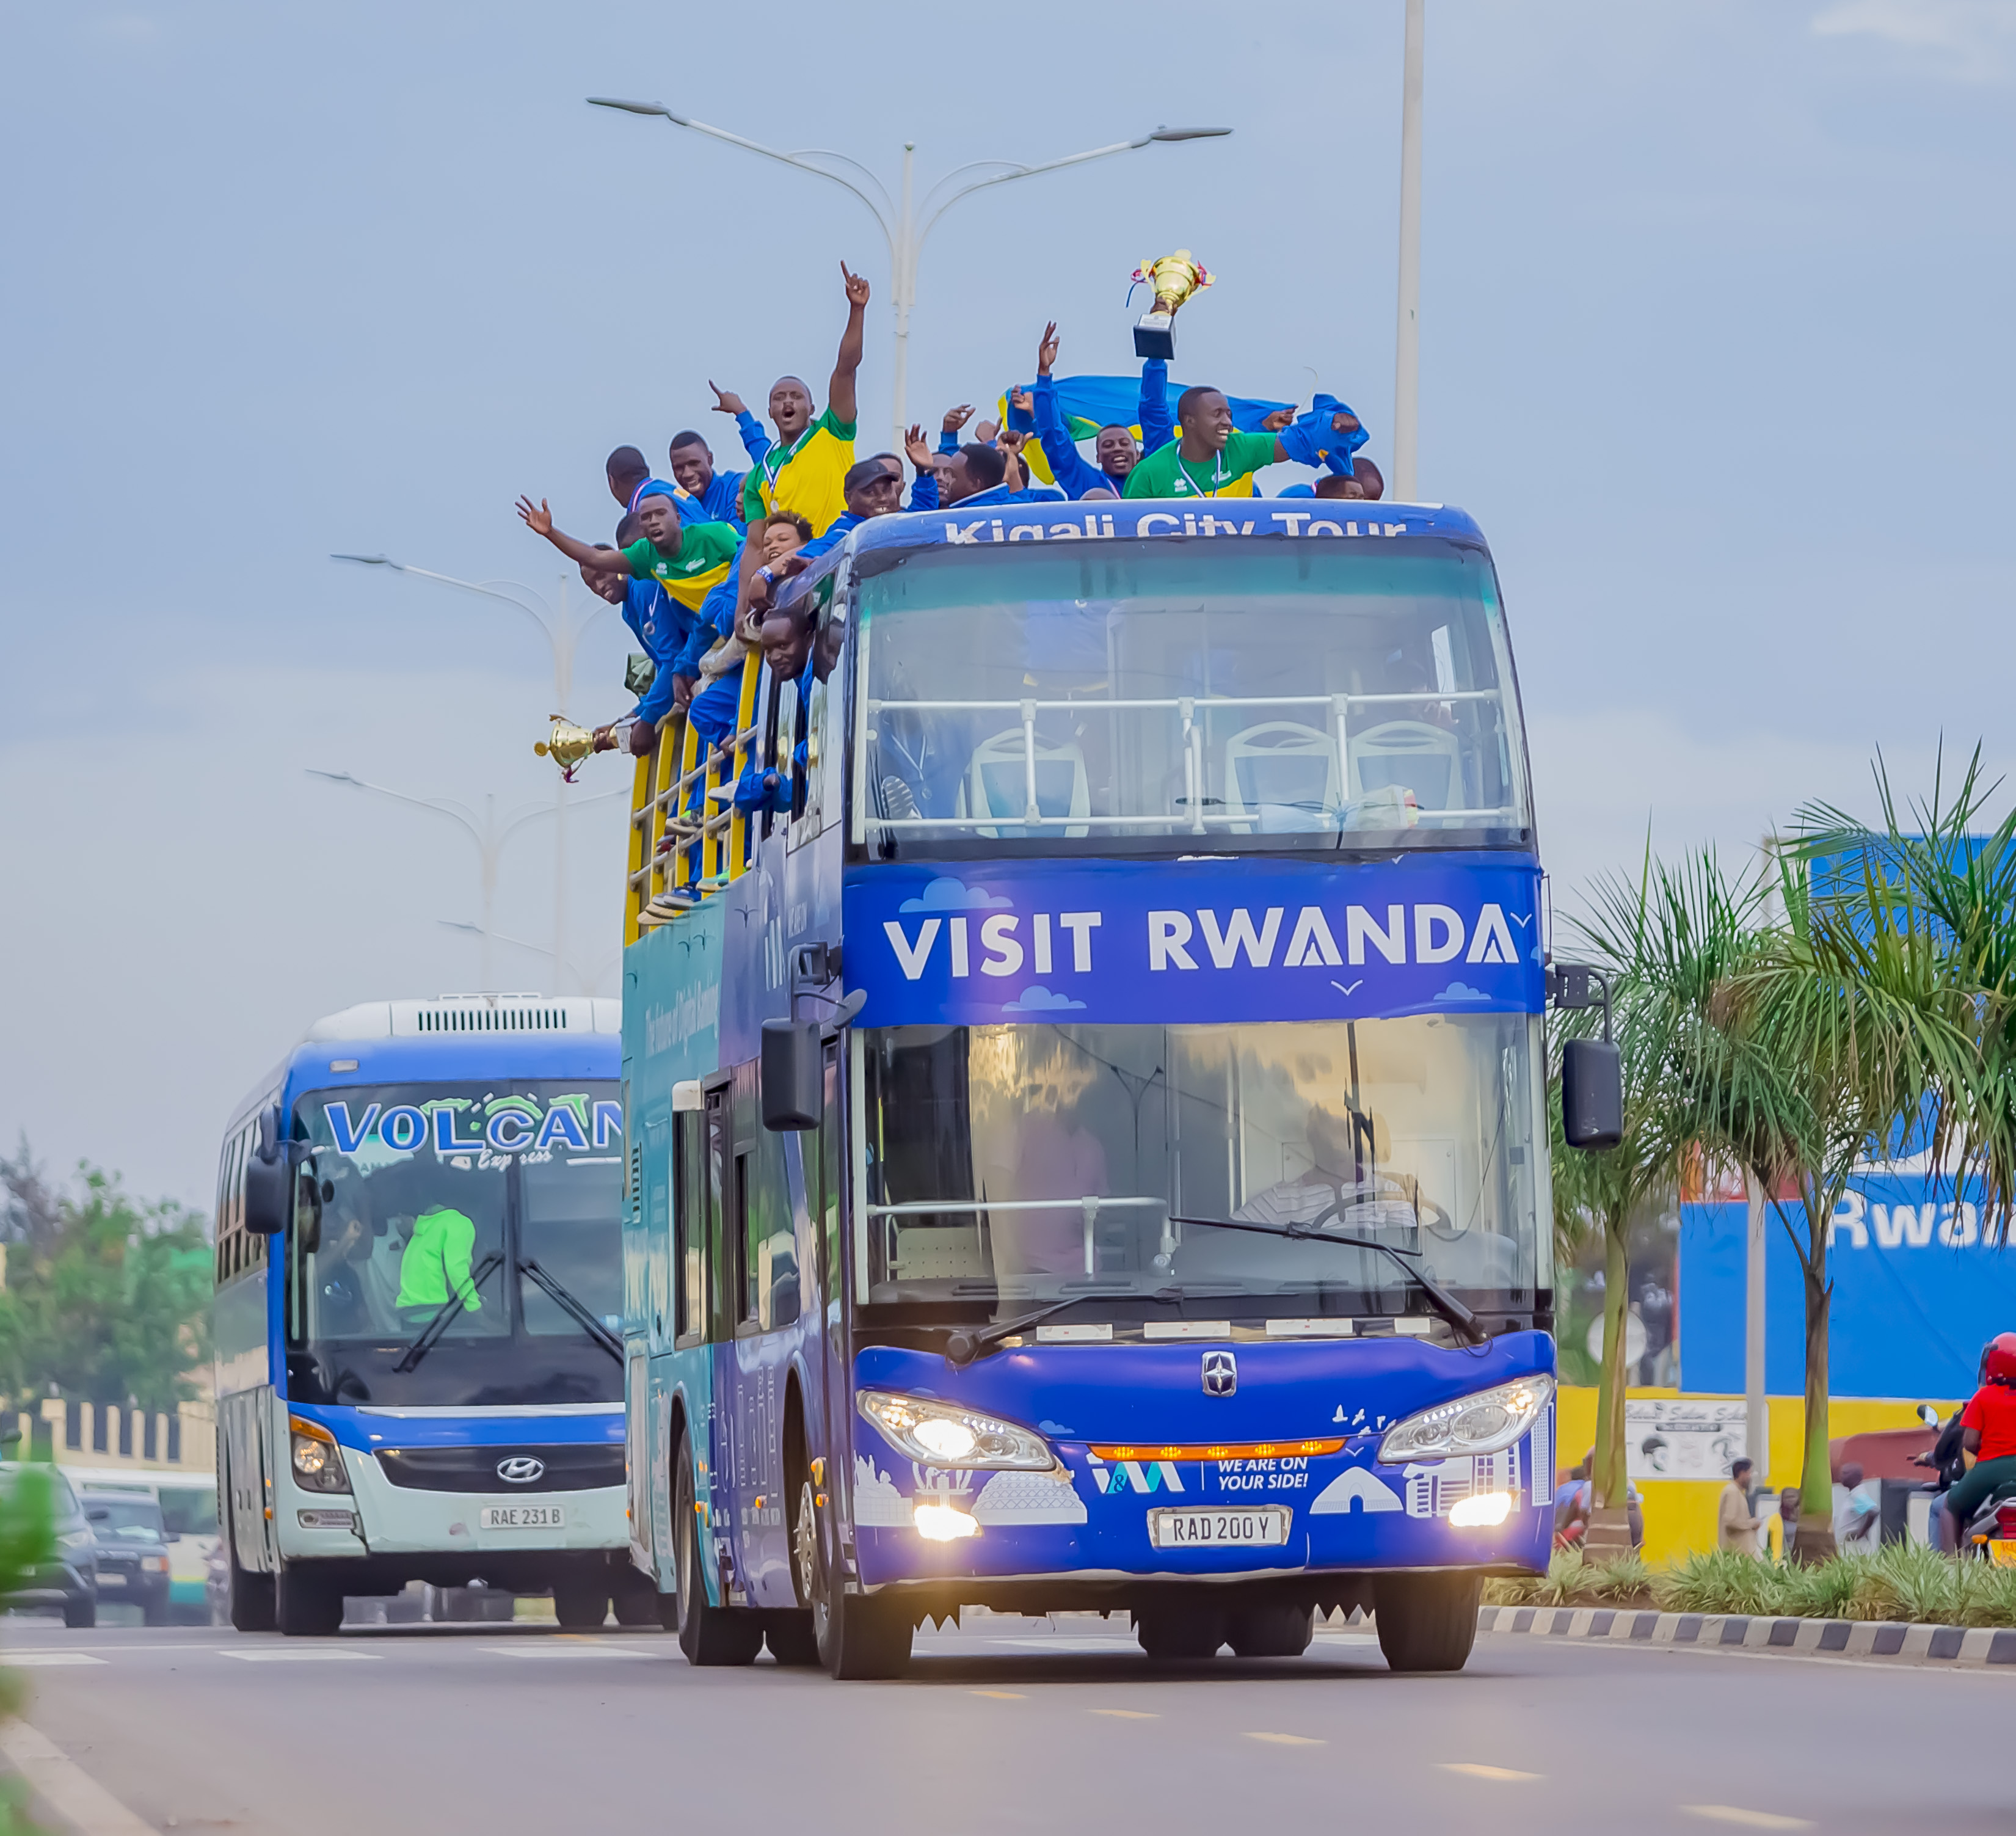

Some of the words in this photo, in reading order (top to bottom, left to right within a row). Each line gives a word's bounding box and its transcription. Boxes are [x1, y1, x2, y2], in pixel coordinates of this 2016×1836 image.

[882, 911, 1102, 980] VISIT
[1148, 903, 1520, 971] RWANDA
[1218, 1459, 1242, 1473] WE
[1245, 1457, 1276, 1472] ARE
[1280, 1456, 1308, 1471] ON
[1218, 1475, 1264, 1491] YOUR
[1267, 1473, 1309, 1489] SIDE!
[490, 1509, 519, 1525] RAE
[522, 1509, 548, 1525] 231
[551, 1508, 561, 1524] B
[1173, 1517, 1212, 1542] RAD
[1217, 1517, 1253, 1540] 200
[1258, 1516, 1269, 1539] Y
